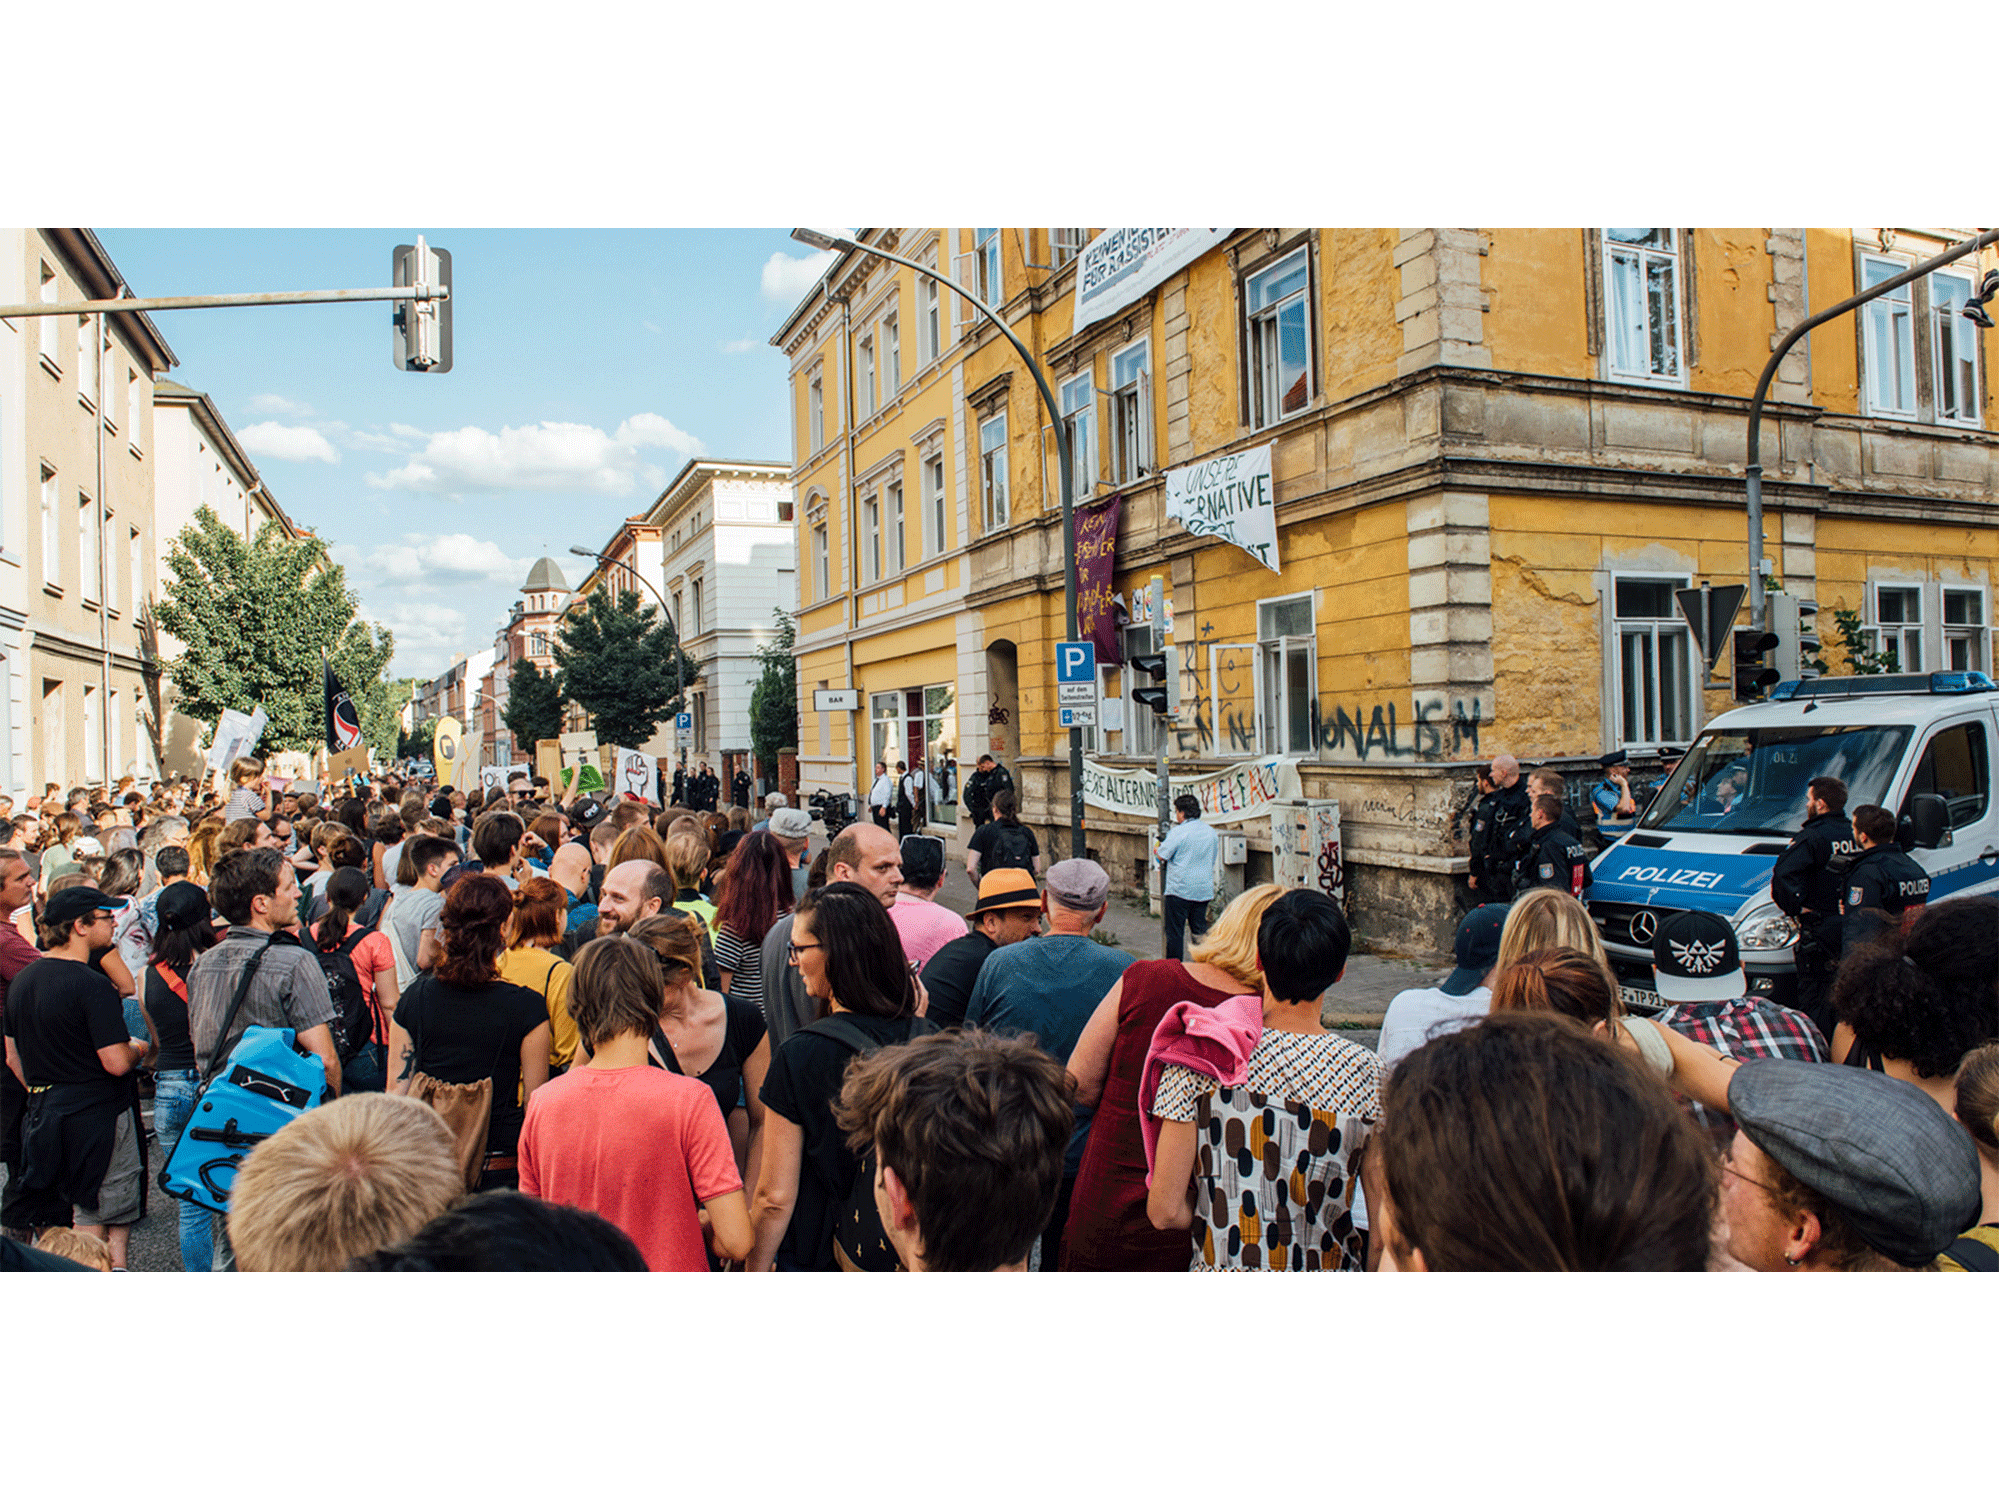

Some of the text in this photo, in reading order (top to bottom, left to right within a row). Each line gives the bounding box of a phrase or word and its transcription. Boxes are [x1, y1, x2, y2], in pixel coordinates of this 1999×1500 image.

[1083, 263, 1107, 292] FÜR
[1065, 648, 1086, 677] P
[828, 696, 844, 704] BAR
[679, 715, 689, 727] P
[1199, 762, 1279, 815] VIELFALT
[1618, 866, 1725, 889] POLIZEI
